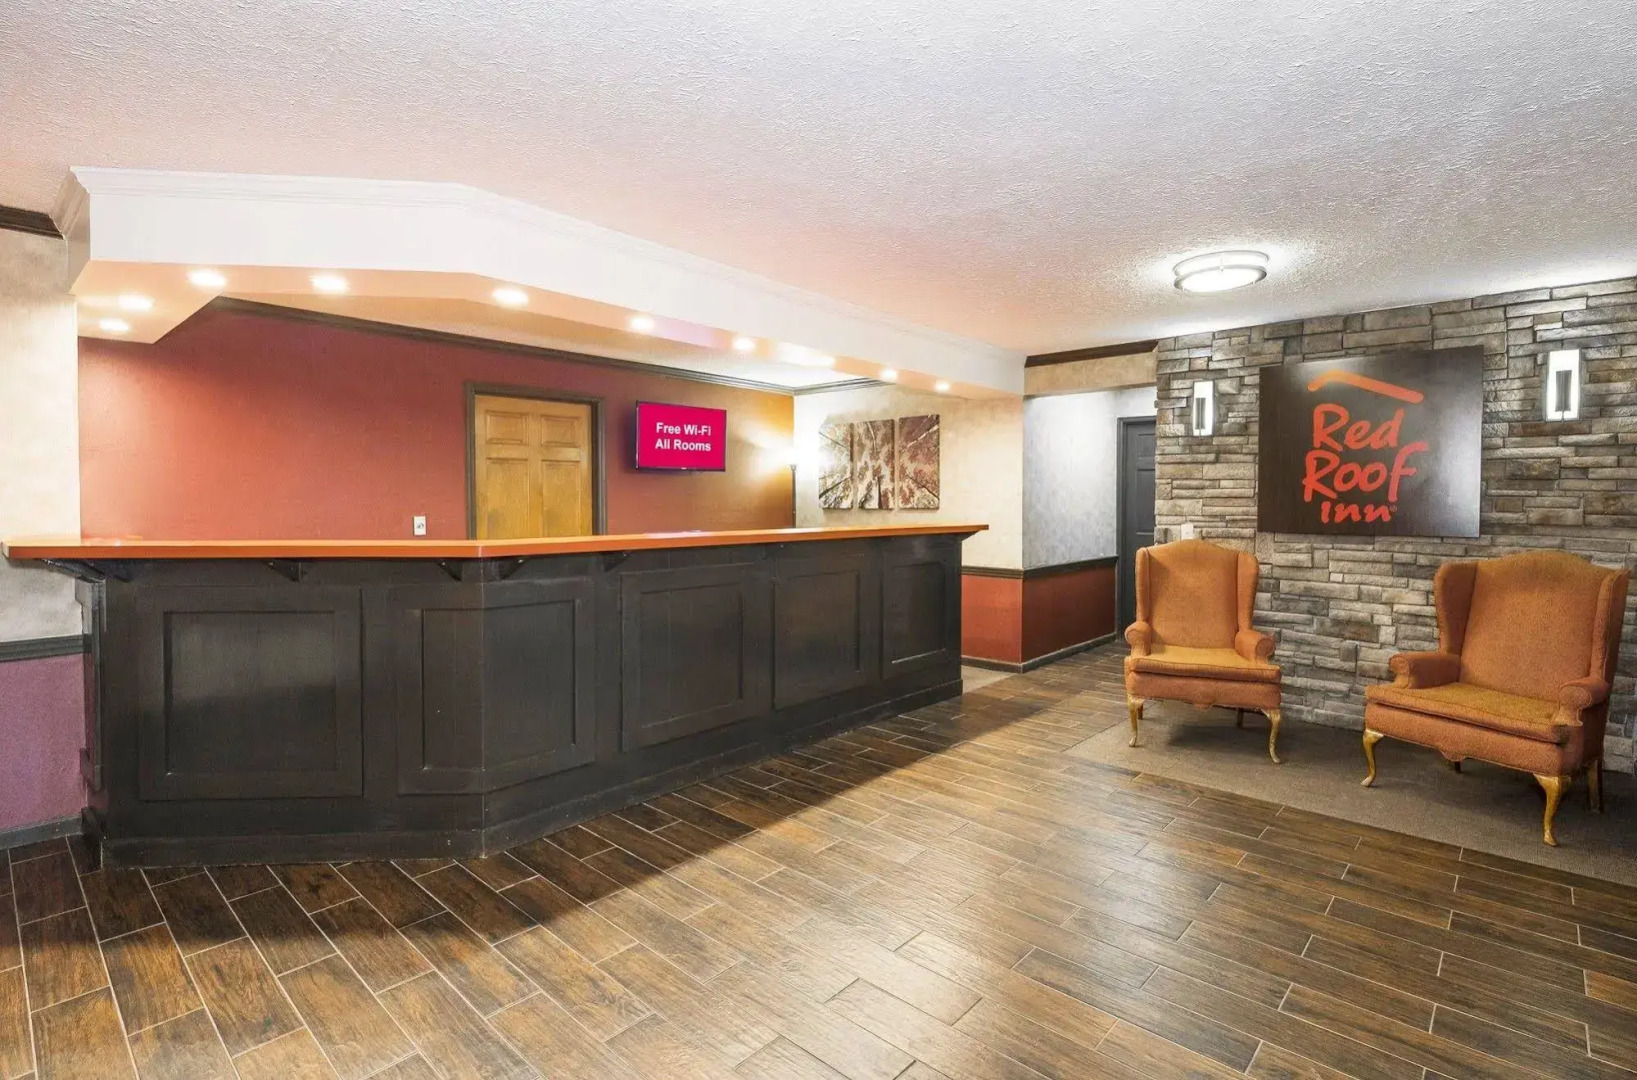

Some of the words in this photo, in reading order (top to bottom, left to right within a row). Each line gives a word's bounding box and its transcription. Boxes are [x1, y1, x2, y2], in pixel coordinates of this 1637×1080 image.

[656, 422, 681, 434] Free
[683, 424, 711, 436] Wi-Fi
[1312, 403, 1405, 451] Red
[655, 438, 670, 450] All
[673, 439, 711, 451] Rooms
[1302, 441, 1428, 502] Roof
